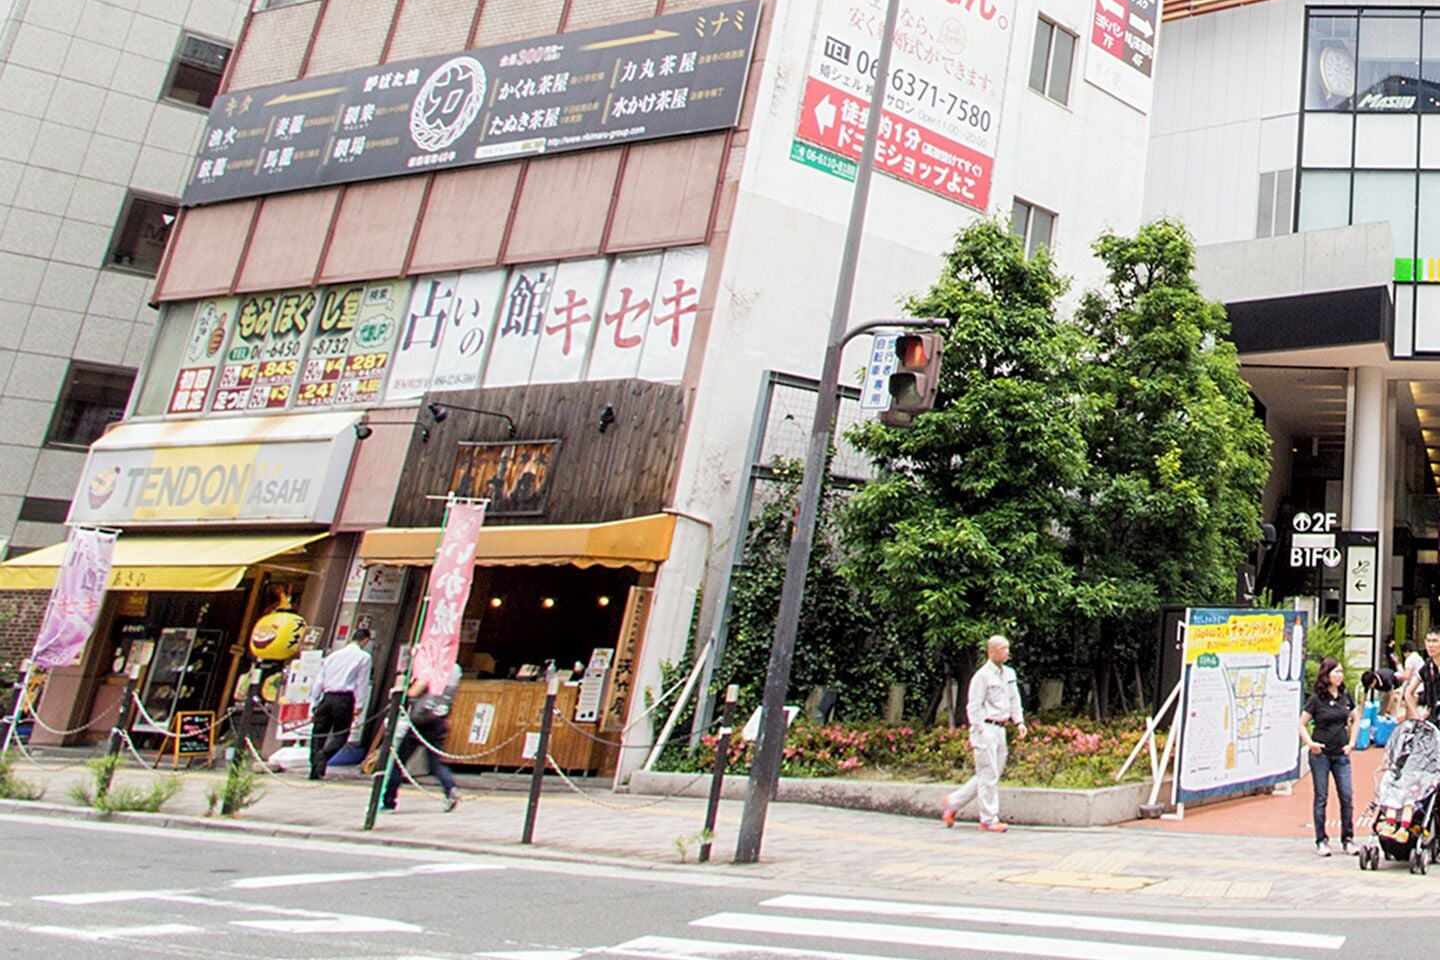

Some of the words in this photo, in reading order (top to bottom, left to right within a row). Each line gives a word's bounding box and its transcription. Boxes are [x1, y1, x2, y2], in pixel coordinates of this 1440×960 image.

[694, 9, 745, 38] ミナミ
[825, 39, 850, 64] TEL
[619, 51, 697, 83] 力丸茶屋
[498, 72, 570, 101] かくれ茶屋
[611, 87, 689, 118] 水かけ茶屋
[488, 107, 561, 136] たぬき茶屋
[402, 271, 549, 358] 占いの館
[545, 278, 698, 357] キセキ
[123, 464, 253, 508] TENDON
[248, 478, 311, 506] ASAHI
[1311, 512, 1337, 532] 2F
[1290, 548, 1323, 568] B1F
